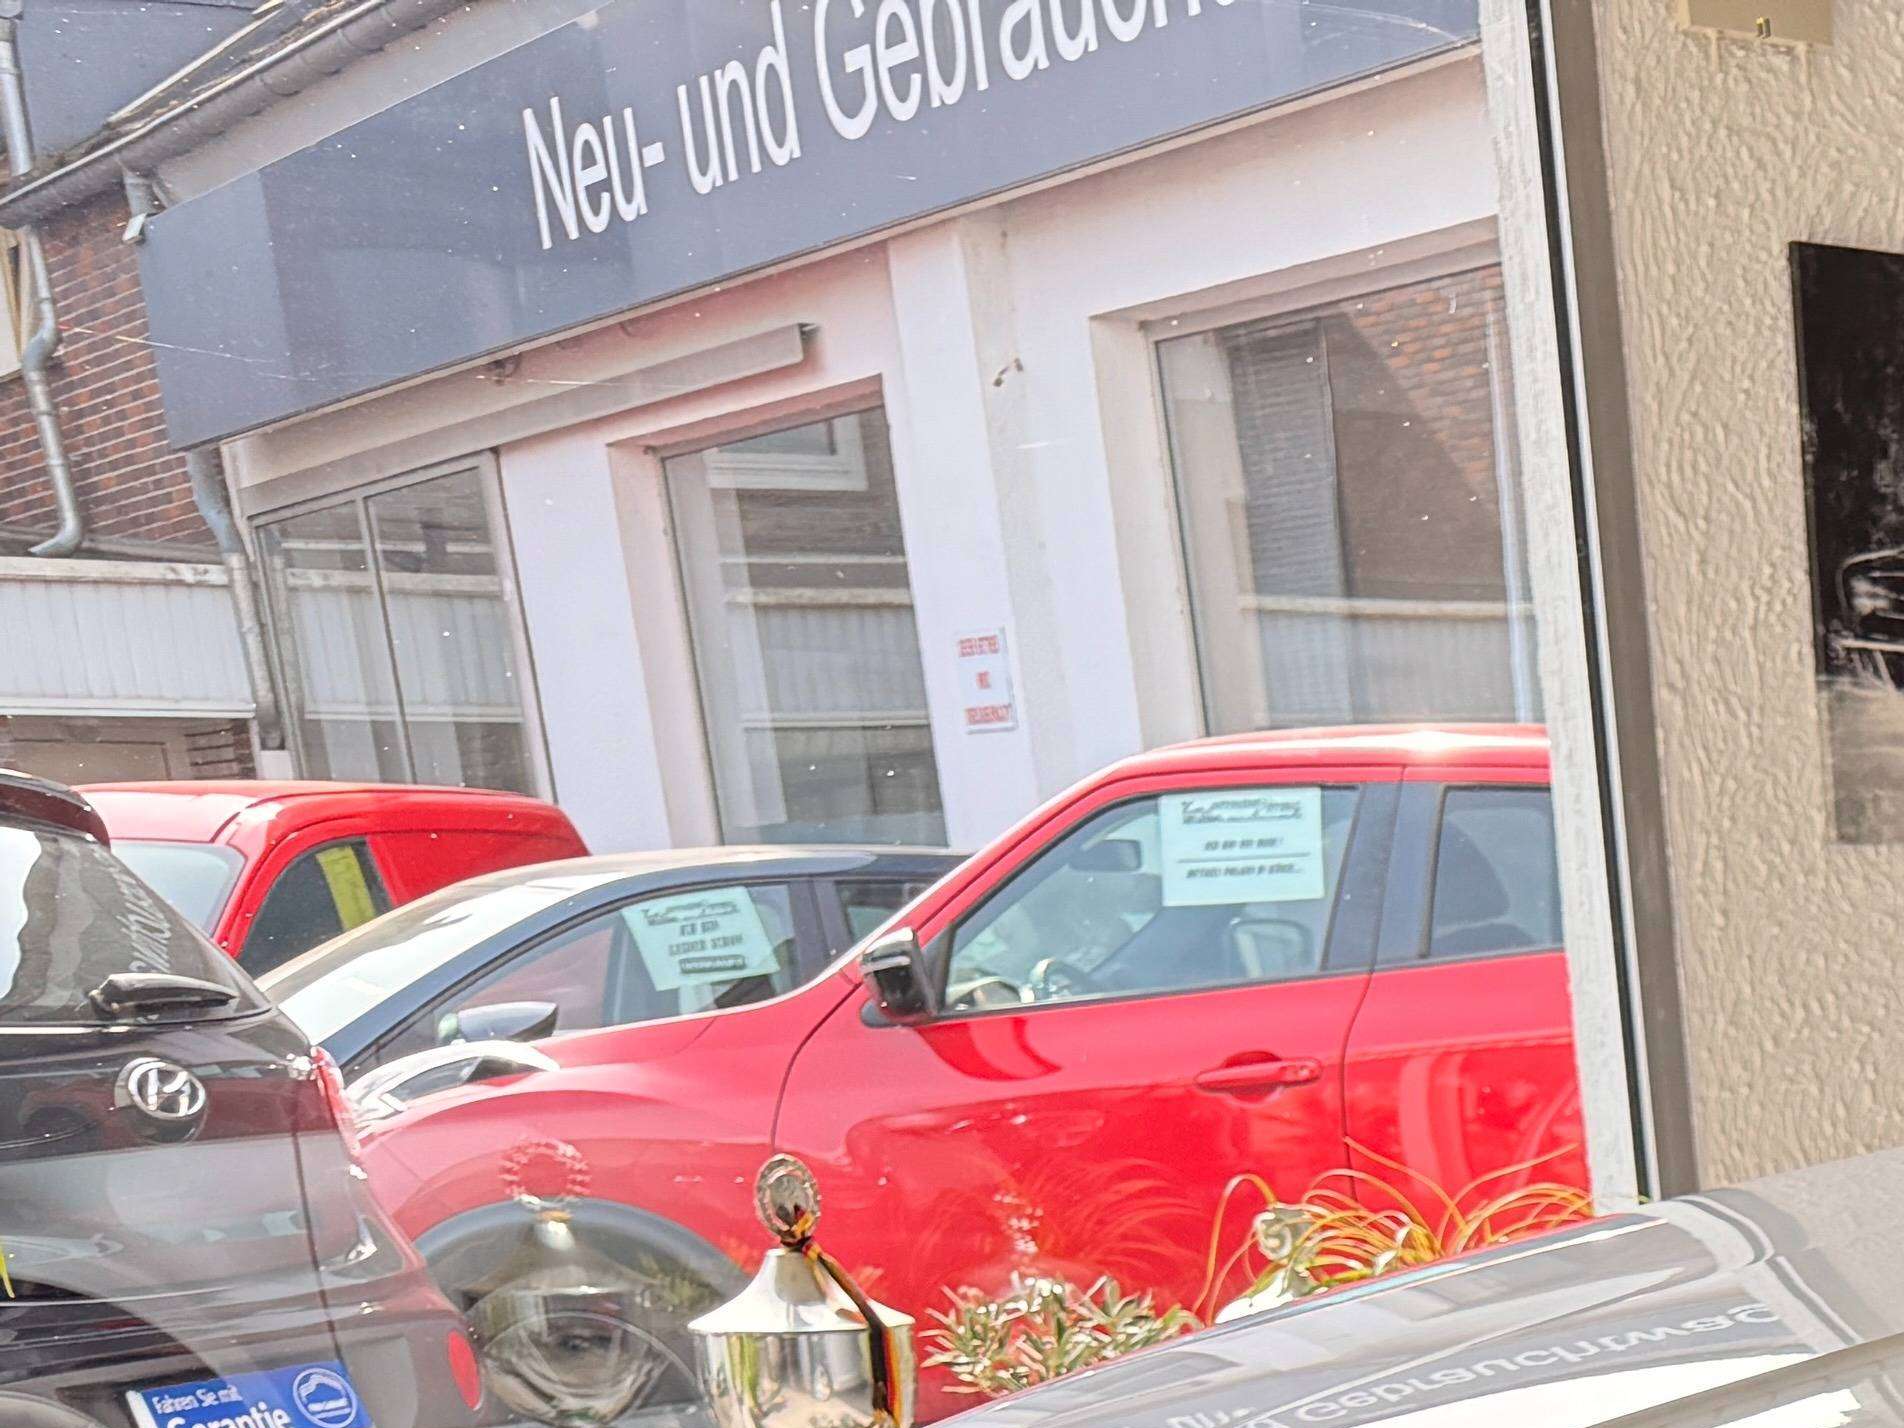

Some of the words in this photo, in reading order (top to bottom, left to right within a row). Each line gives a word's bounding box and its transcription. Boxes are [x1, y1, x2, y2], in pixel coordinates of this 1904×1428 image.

[523, 96, 666, 251] Neu-
[677, 0, 802, 195] und
[152, 1392, 198, 1415] Fahren
[196, 1386, 217, 1408] Sie
[218, 1384, 243, 1403] mit
